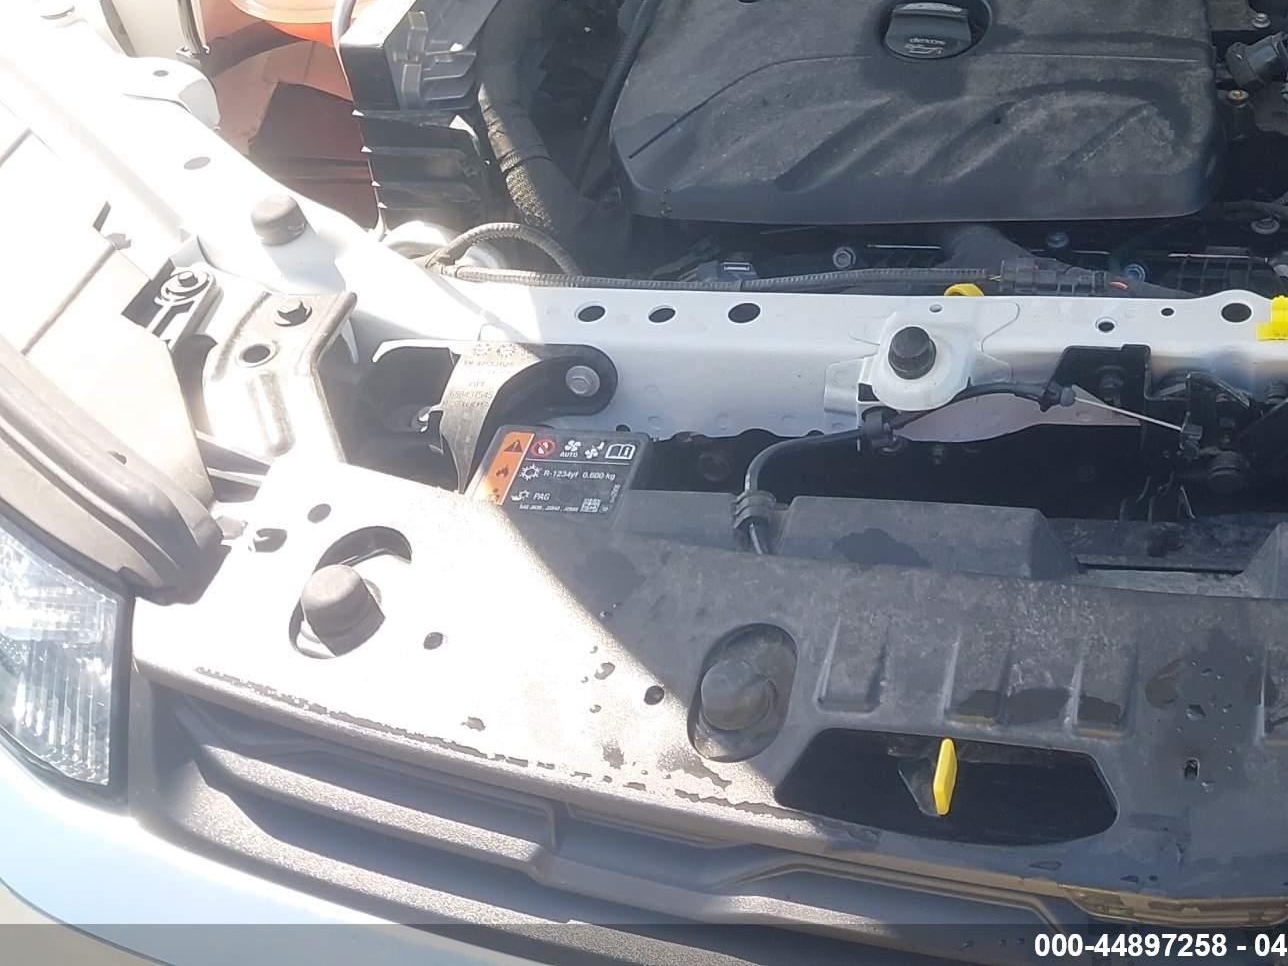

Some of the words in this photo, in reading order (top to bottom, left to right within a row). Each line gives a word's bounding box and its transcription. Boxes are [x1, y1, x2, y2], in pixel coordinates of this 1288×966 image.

[543, 469, 579, 480] R-1234yf
[605, 472, 616, 481] kg
[533, 492, 550, 501] PAG
